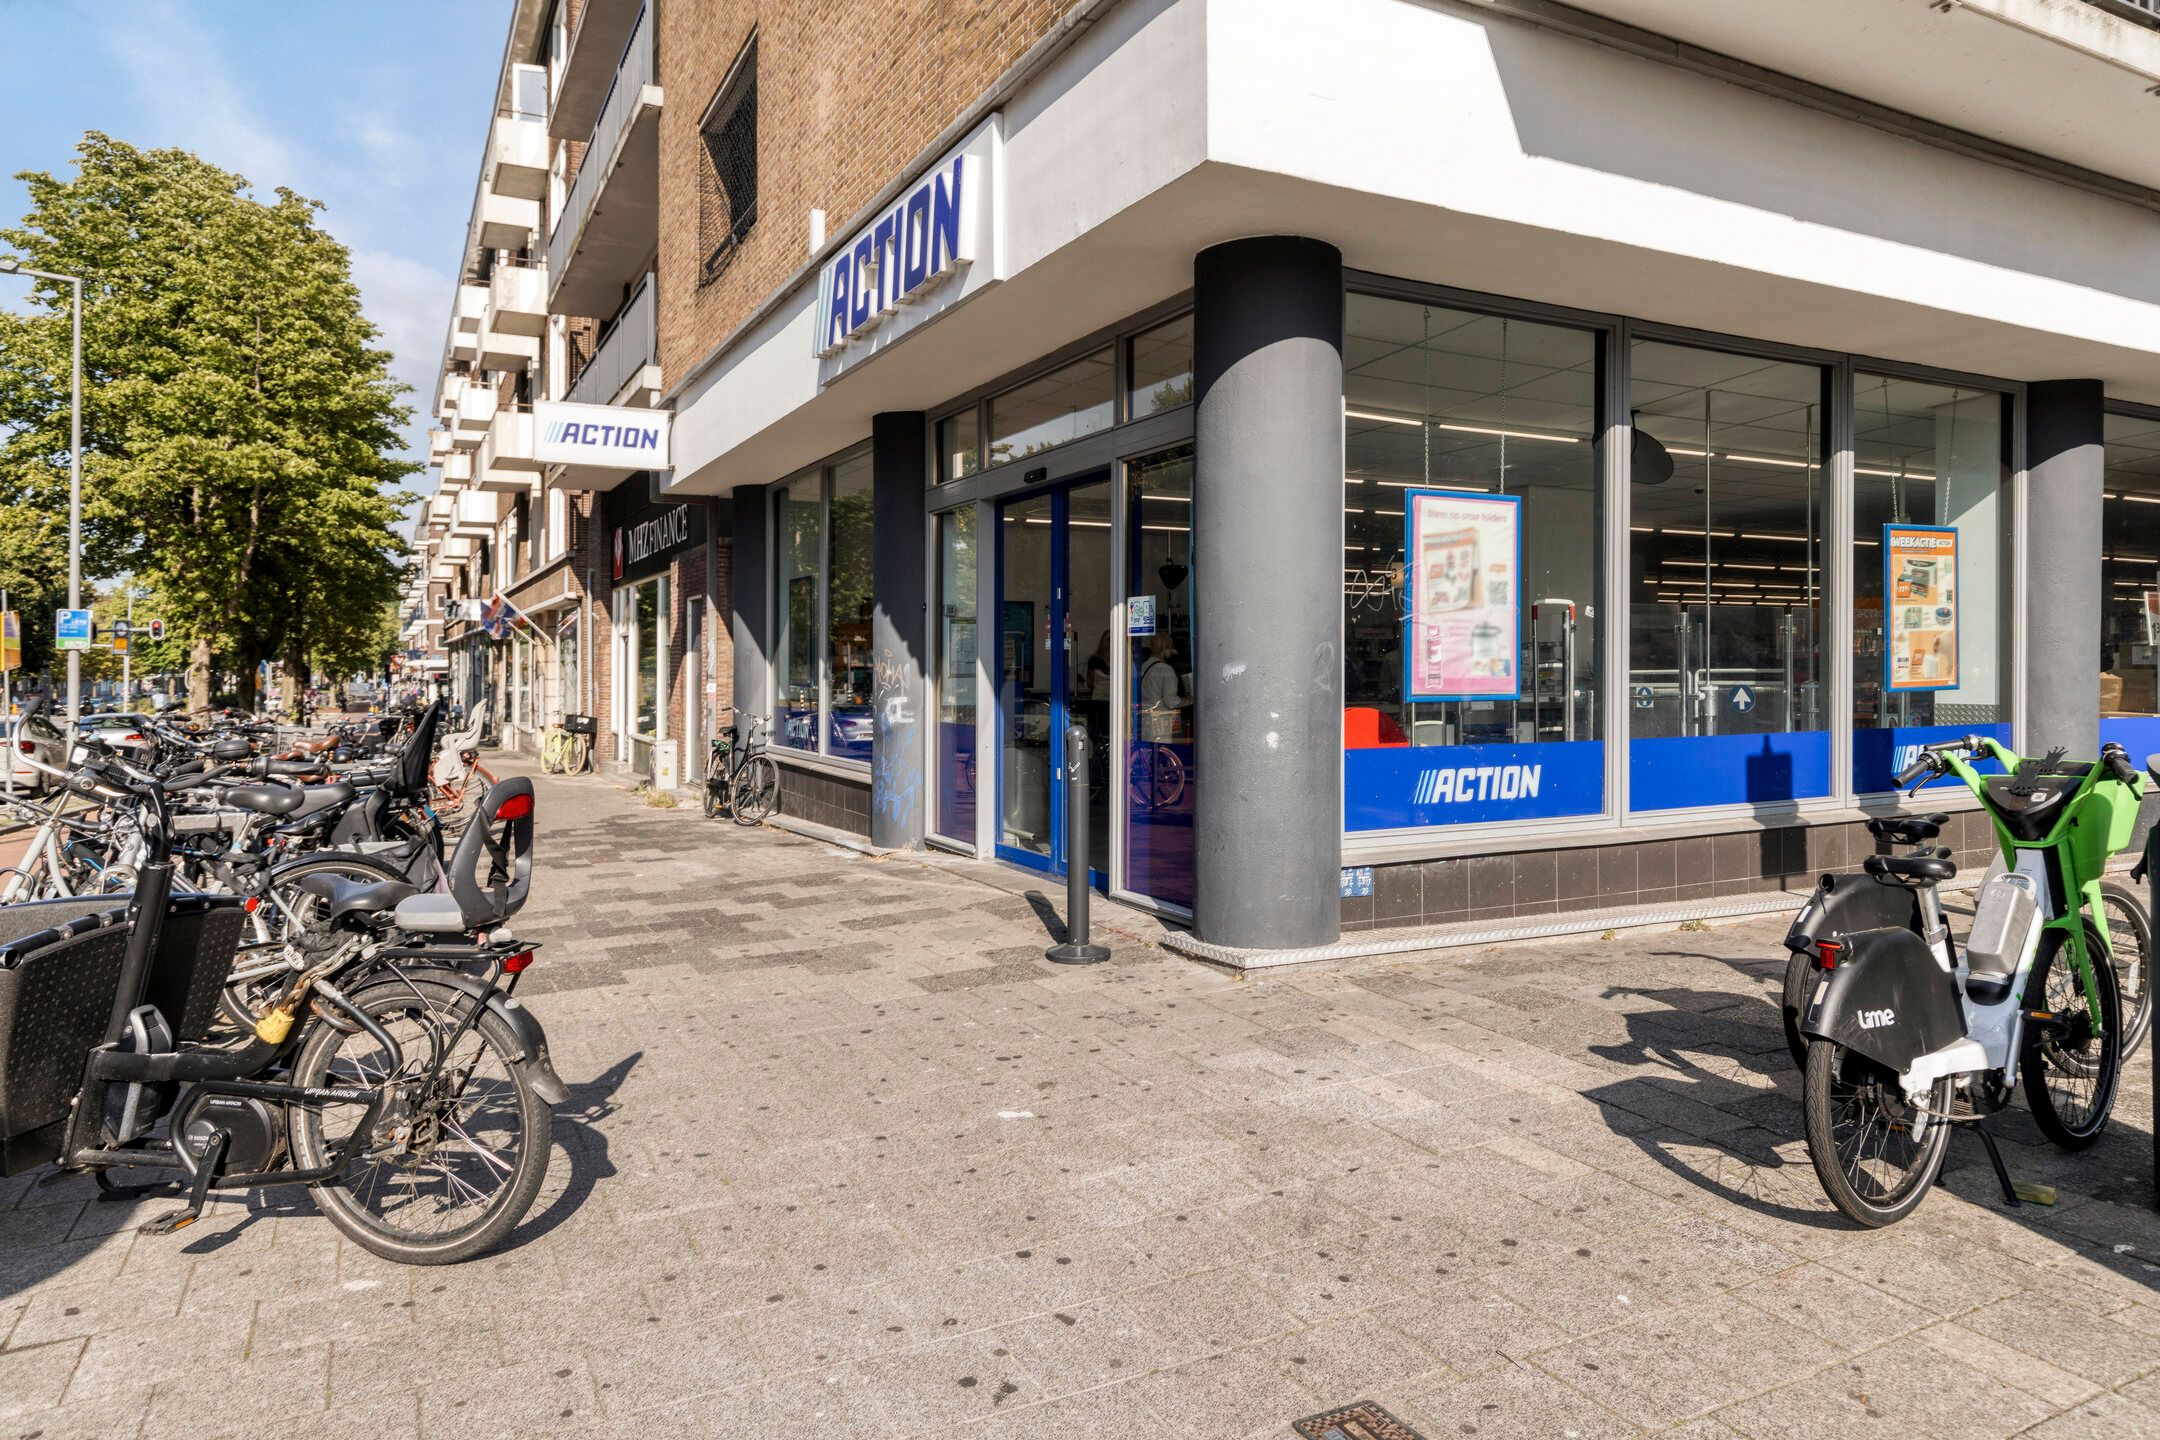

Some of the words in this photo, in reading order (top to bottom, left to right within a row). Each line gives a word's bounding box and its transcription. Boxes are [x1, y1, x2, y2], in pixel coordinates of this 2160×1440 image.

[828, 154, 963, 348] ACTION
[560, 423, 659, 449] ACTION
[1891, 535, 1937, 549] WEEKACTIE
[1430, 764, 1542, 804] ACTION
[304, 1087, 330, 1097] URBAN
[330, 1089, 360, 1098] ARROW
